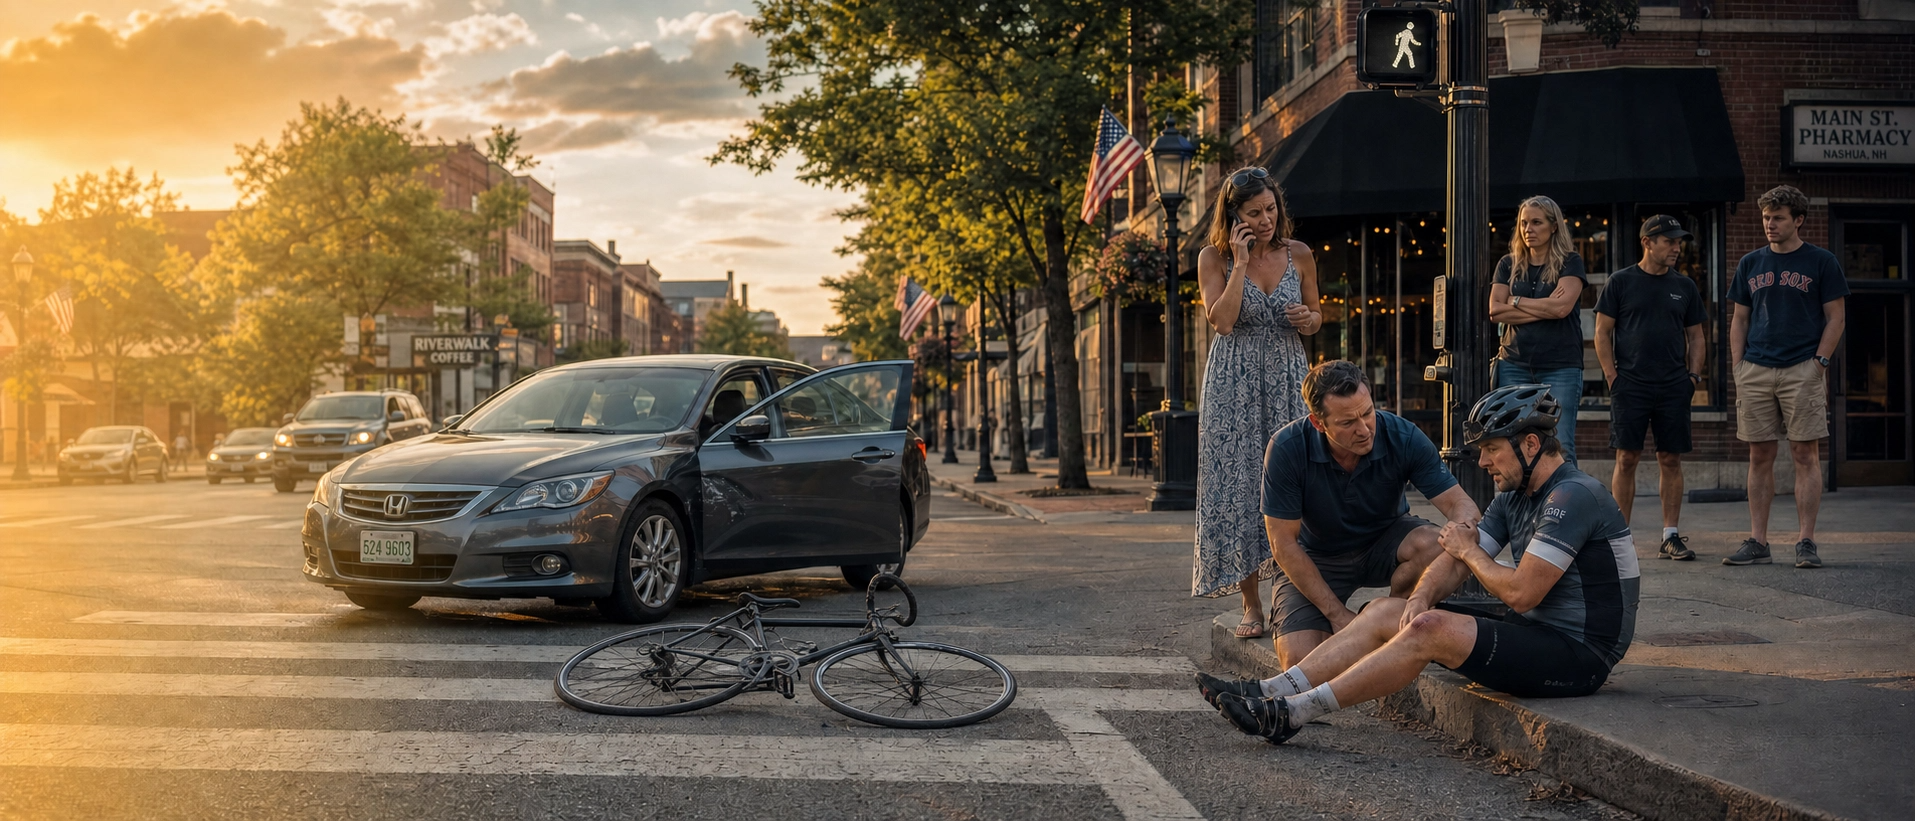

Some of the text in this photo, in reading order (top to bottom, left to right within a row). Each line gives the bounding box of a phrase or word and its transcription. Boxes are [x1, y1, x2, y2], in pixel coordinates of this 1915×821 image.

[1811, 109, 1899, 126] MAIN ST.
[1799, 128, 1912, 146] PHARMACY
[1823, 149, 1887, 160] NASHUA, NH
[1748, 270, 1814, 294] RED SOX
[414, 337, 491, 351] RIVERWALK
[430, 351, 475, 363] COFFEE
[363, 539, 412, 557] 524 9603
